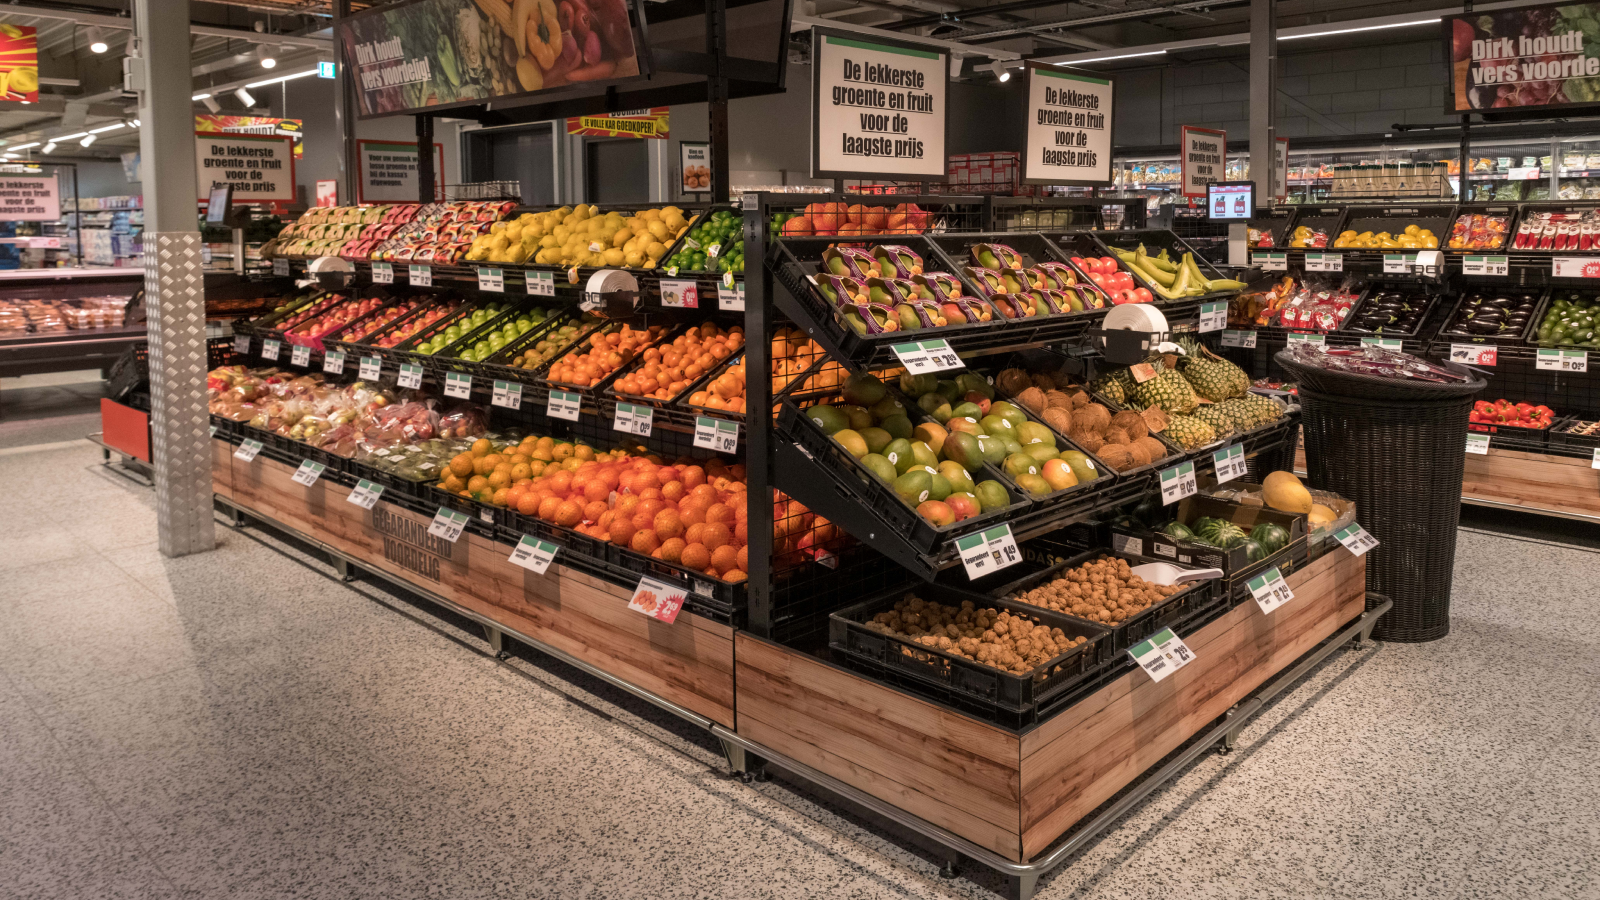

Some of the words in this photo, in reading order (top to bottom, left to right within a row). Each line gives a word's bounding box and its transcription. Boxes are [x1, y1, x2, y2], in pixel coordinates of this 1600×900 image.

[355, 42, 376, 65] Dirk
[374, 36, 404, 61] houdt
[1472, 37, 1515, 60] Dirk
[1519, 30, 1584, 56] houdt
[361, 70, 382, 90] vers
[381, 56, 432, 86] voordelig!
[844, 59, 861, 80] De
[865, 62, 924, 88] lekkerste
[1472, 64, 1517, 84] vers
[1522, 55, 1600, 80] voorde
[833, 86, 885, 107] groente
[889, 92, 904, 109] en
[907, 91, 933, 112] fruit
[1046, 87, 1057, 104] De
[1059, 88, 1099, 109] lekkerste
[584, 118, 590, 127] JE
[590, 119, 604, 129] VOLLE
[605, 120, 615, 130] KAR
[616, 120, 654, 134] GOEDKOPER!
[860, 113, 889, 131] voor
[892, 113, 908, 133] de
[1038, 109, 1072, 126] groente
[1075, 113, 1085, 127] en
[1087, 112, 1104, 129] fruit
[843, 133, 892, 157] laagste
[895, 138, 924, 159] prijs
[1055, 131, 1074, 146] voor
[1076, 130, 1087, 146] de
[1192, 140, 1198, 150] De
[1199, 141, 1217, 152] lekkerste
[211, 145, 225, 156] De
[227, 146, 274, 157] lekkerste
[1043, 147, 1076, 167] laagste
[1077, 150, 1097, 167] prijs
[1189, 153, 1205, 162] groente
[204, 158, 244, 168] groente
[247, 160, 259, 168] en
[261, 159, 282, 168] fruit
[1197, 165, 1206, 174] voor
[1207, 165, 1212, 175] de
[6, 181, 44, 189] lekkerste
[225, 170, 248, 179] voor
[250, 170, 262, 180] de
[253, 182, 275, 191] prijs
[373, 506, 451, 558] GEGARANDEERD
[384, 537, 440, 583] VOORDELIG
[1003, 544, 1016, 562] 1.49
